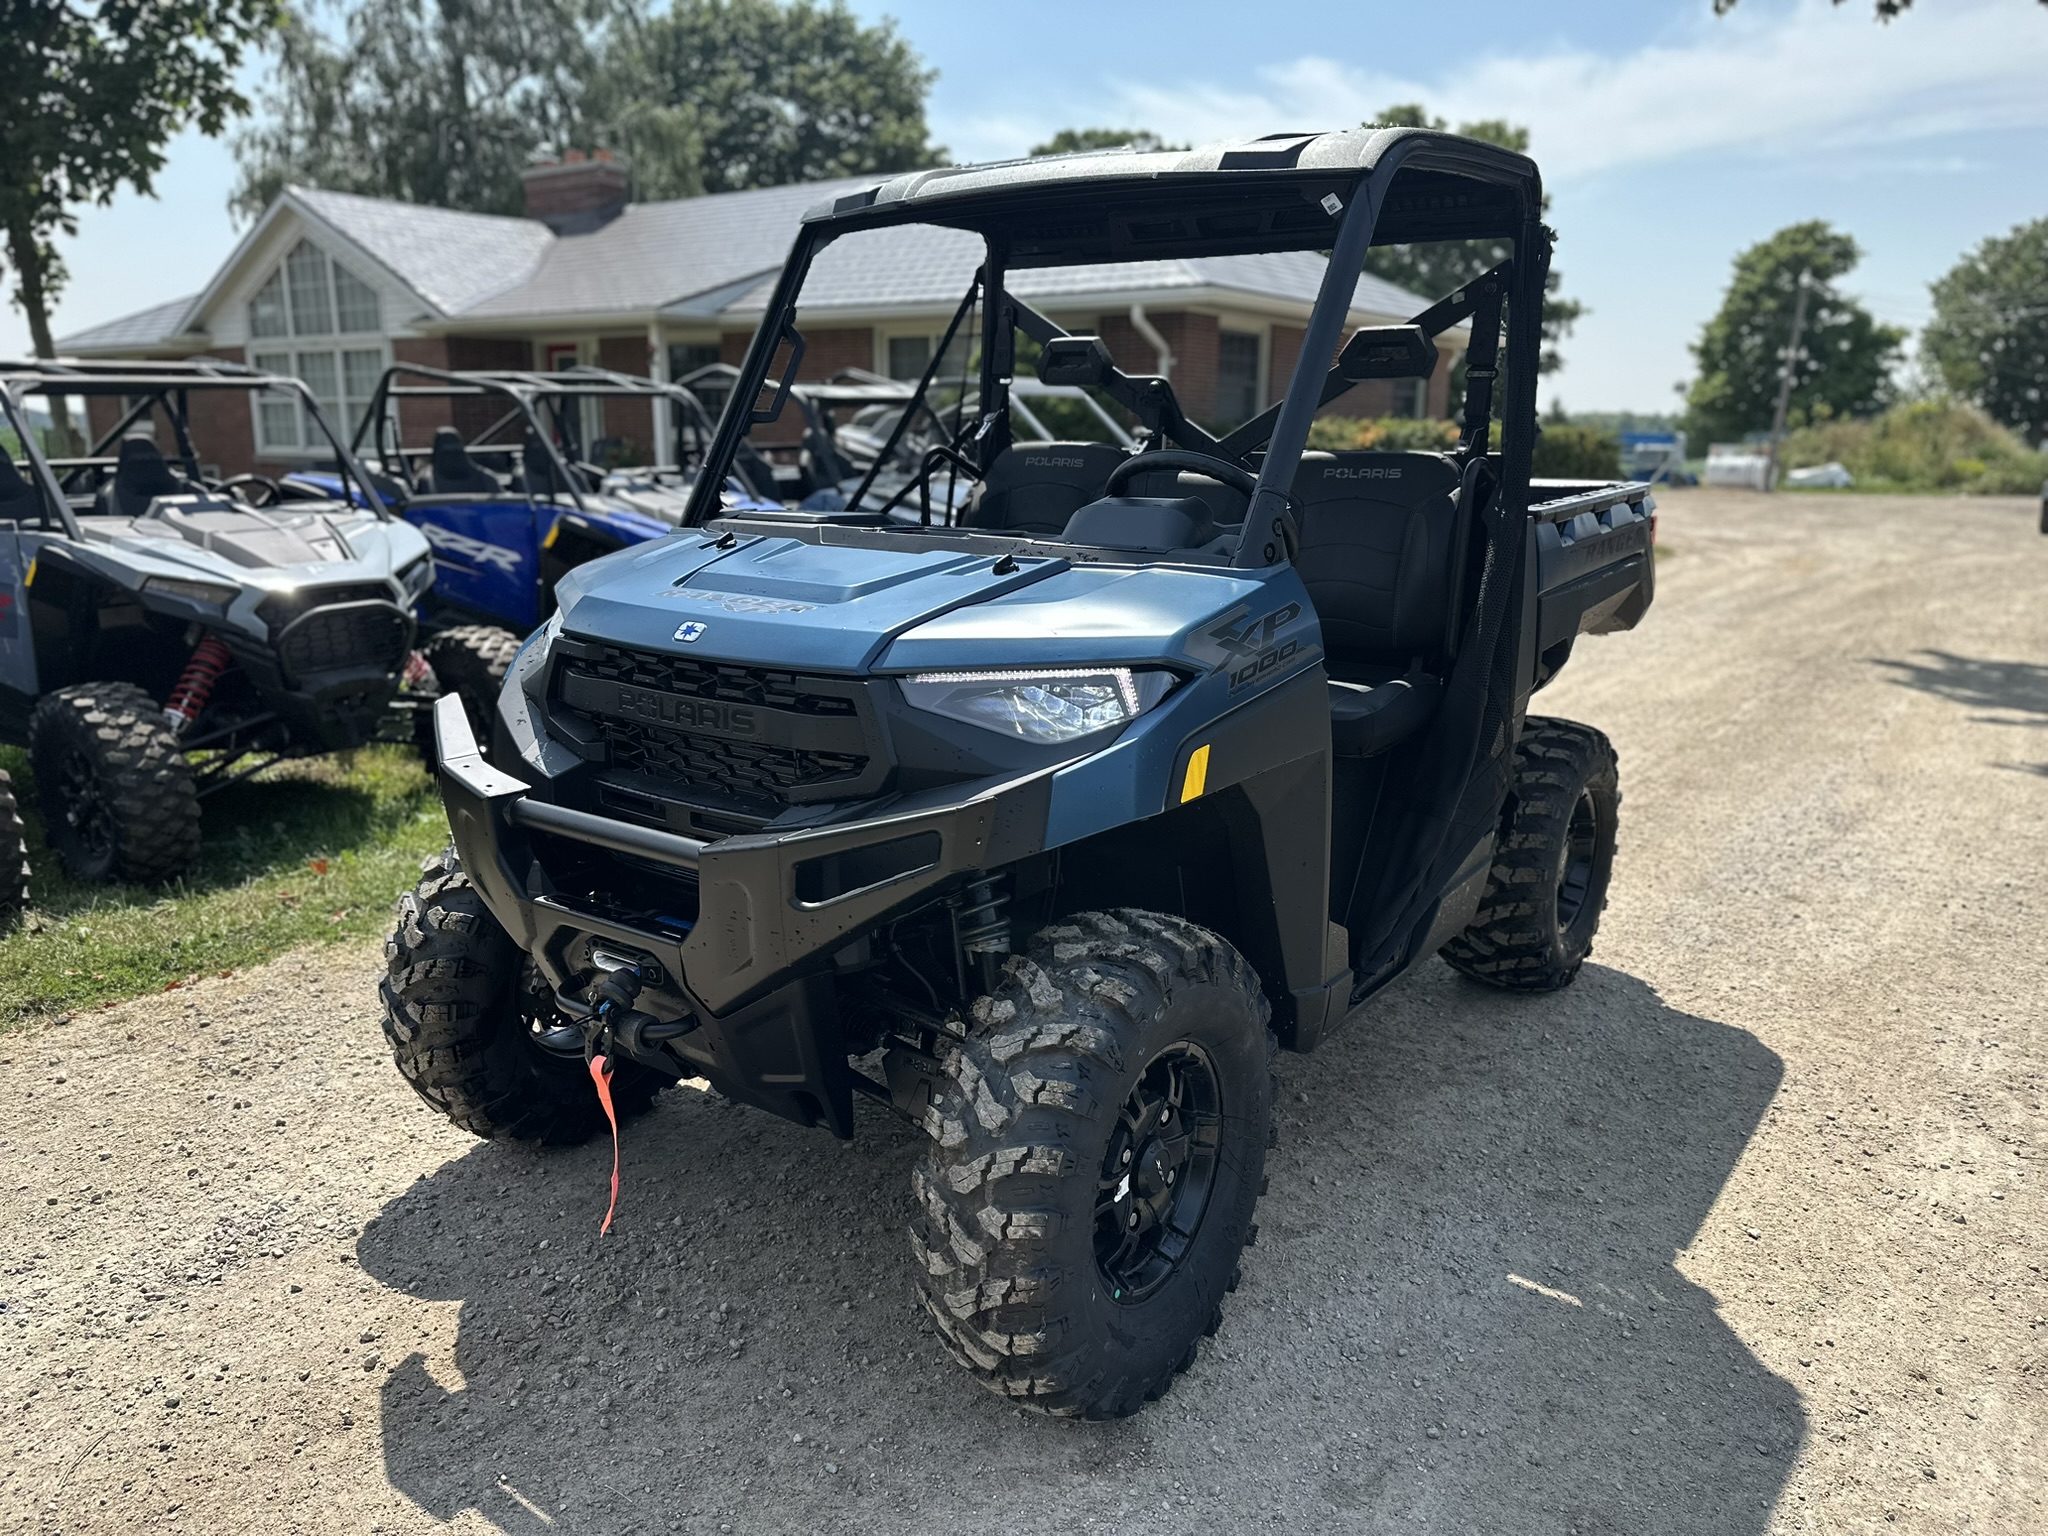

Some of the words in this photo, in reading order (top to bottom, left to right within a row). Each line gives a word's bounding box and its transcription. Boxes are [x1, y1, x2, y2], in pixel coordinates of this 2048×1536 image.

[1025, 456, 1085, 468] POLARIS
[1323, 467, 1402, 479] POLARIS
[420, 522, 522, 573] RZR
[1208, 600, 1302, 678] XP
[1228, 638, 1298, 690] 1000
[618, 686, 756, 737] POLARIS
